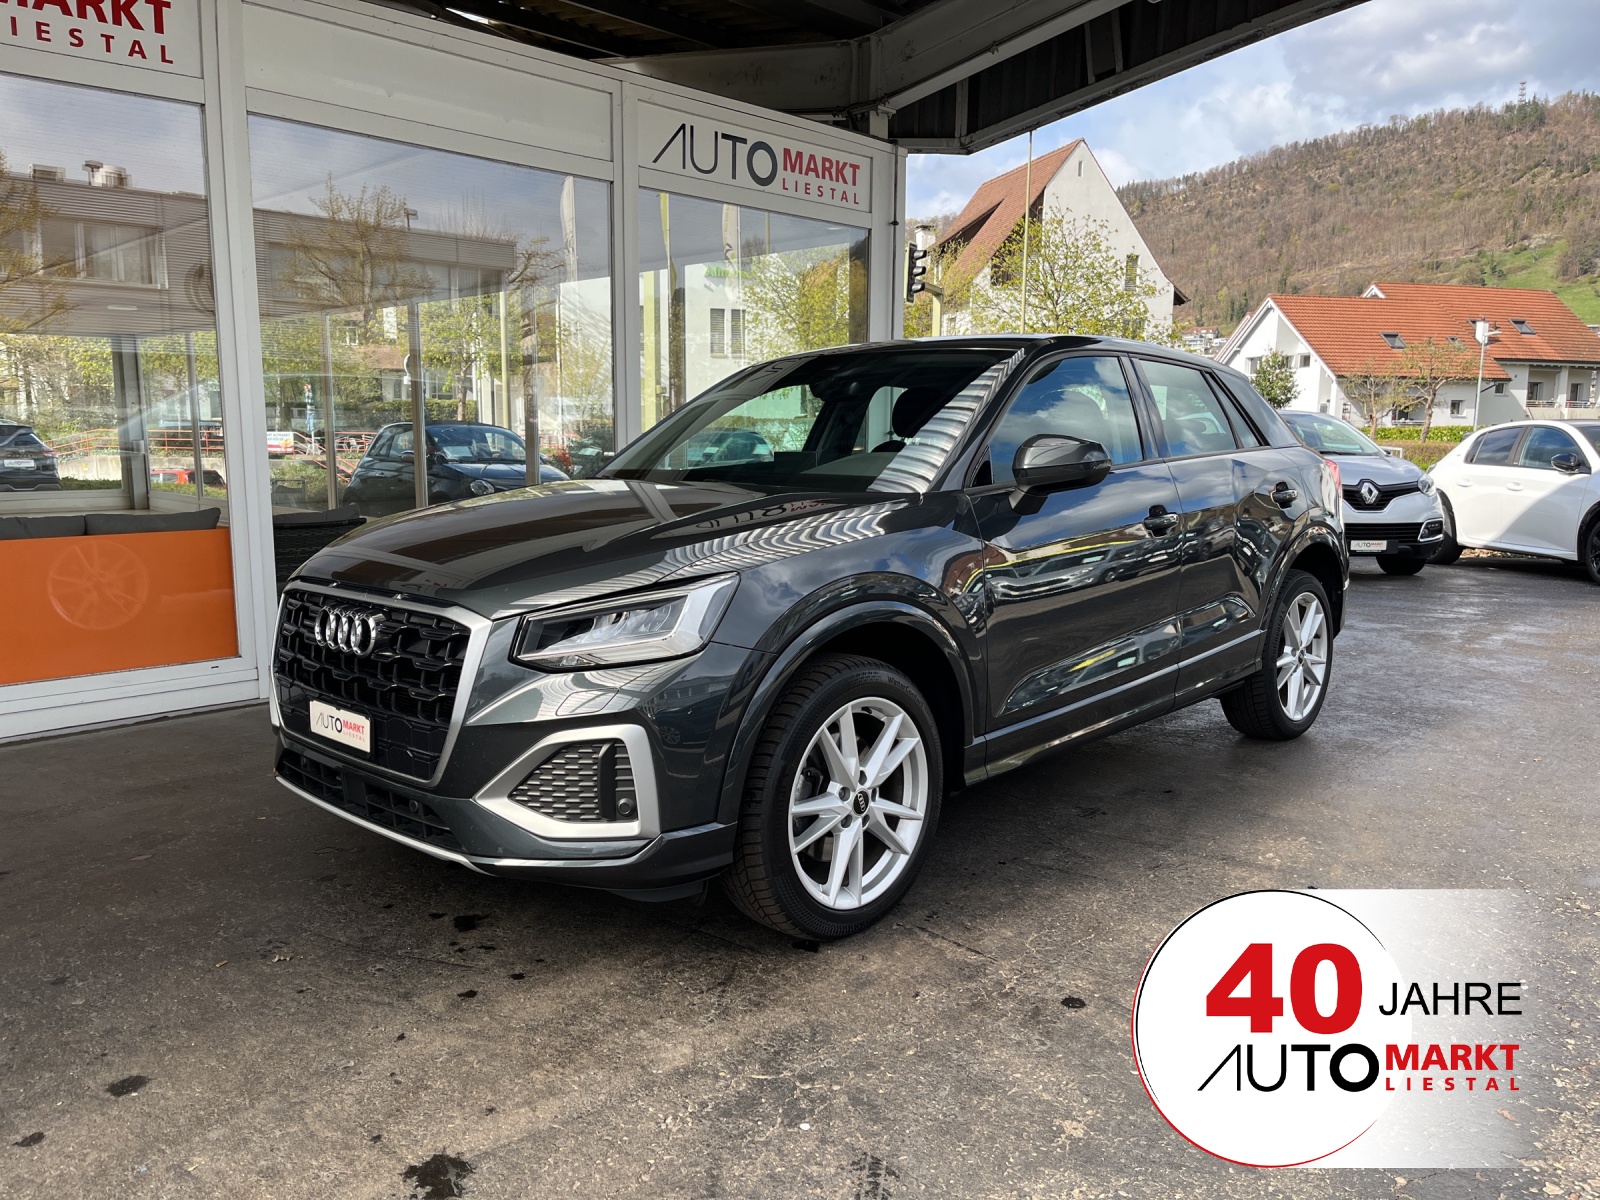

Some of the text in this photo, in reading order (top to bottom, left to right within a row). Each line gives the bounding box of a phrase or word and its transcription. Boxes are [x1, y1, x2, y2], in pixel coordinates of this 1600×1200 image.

[0, 0, 171, 34] RKT
[10, 16, 173, 64] IESTAL
[652, 123, 860, 186] AUTO MARKT
[782, 178, 859, 205] LIESTAL
[316, 712, 365, 735] AUTO MARKT
